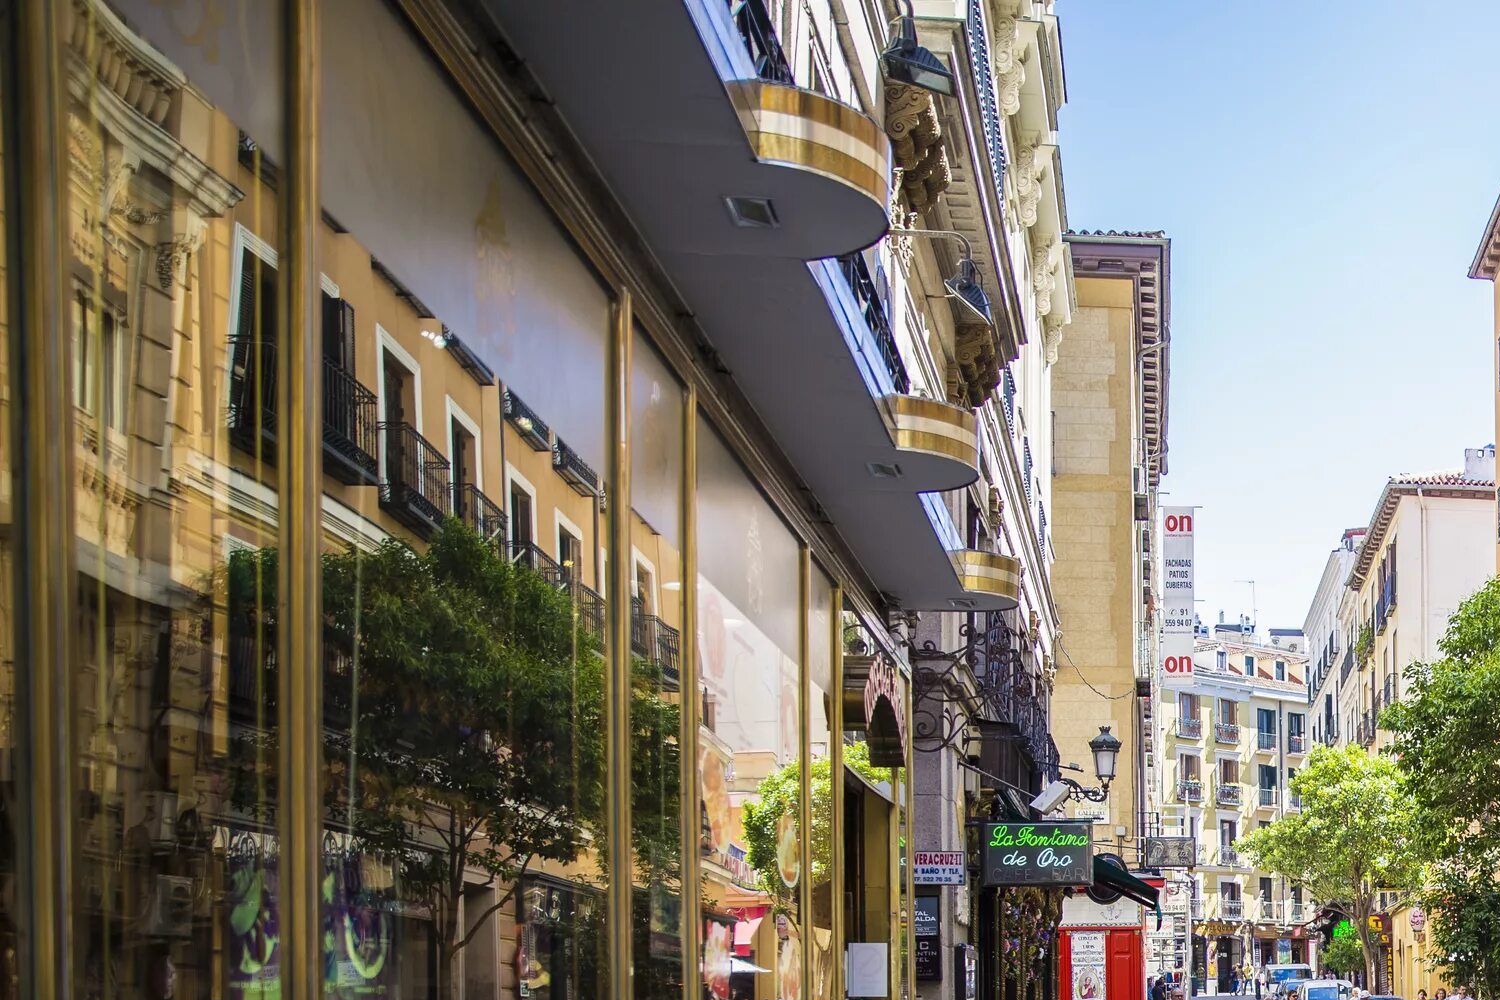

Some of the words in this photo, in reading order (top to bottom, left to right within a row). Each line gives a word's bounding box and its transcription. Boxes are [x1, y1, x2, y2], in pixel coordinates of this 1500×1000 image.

[1165, 515, 1192, 532] on
[1165, 559, 1192, 568] FACHADAS
[1168, 570, 1188, 579] PATIOS
[1165, 581, 1192, 589] CUBIERTAS
[1180, 608, 1188, 616] 91
[1178, 619, 1184, 627] 94
[1165, 655, 1192, 673] on
[989, 825, 1014, 847] La
[1002, 850, 1028, 867] de
[1036, 847, 1073, 868] Oro
[921, 866, 940, 875] BAÑO
